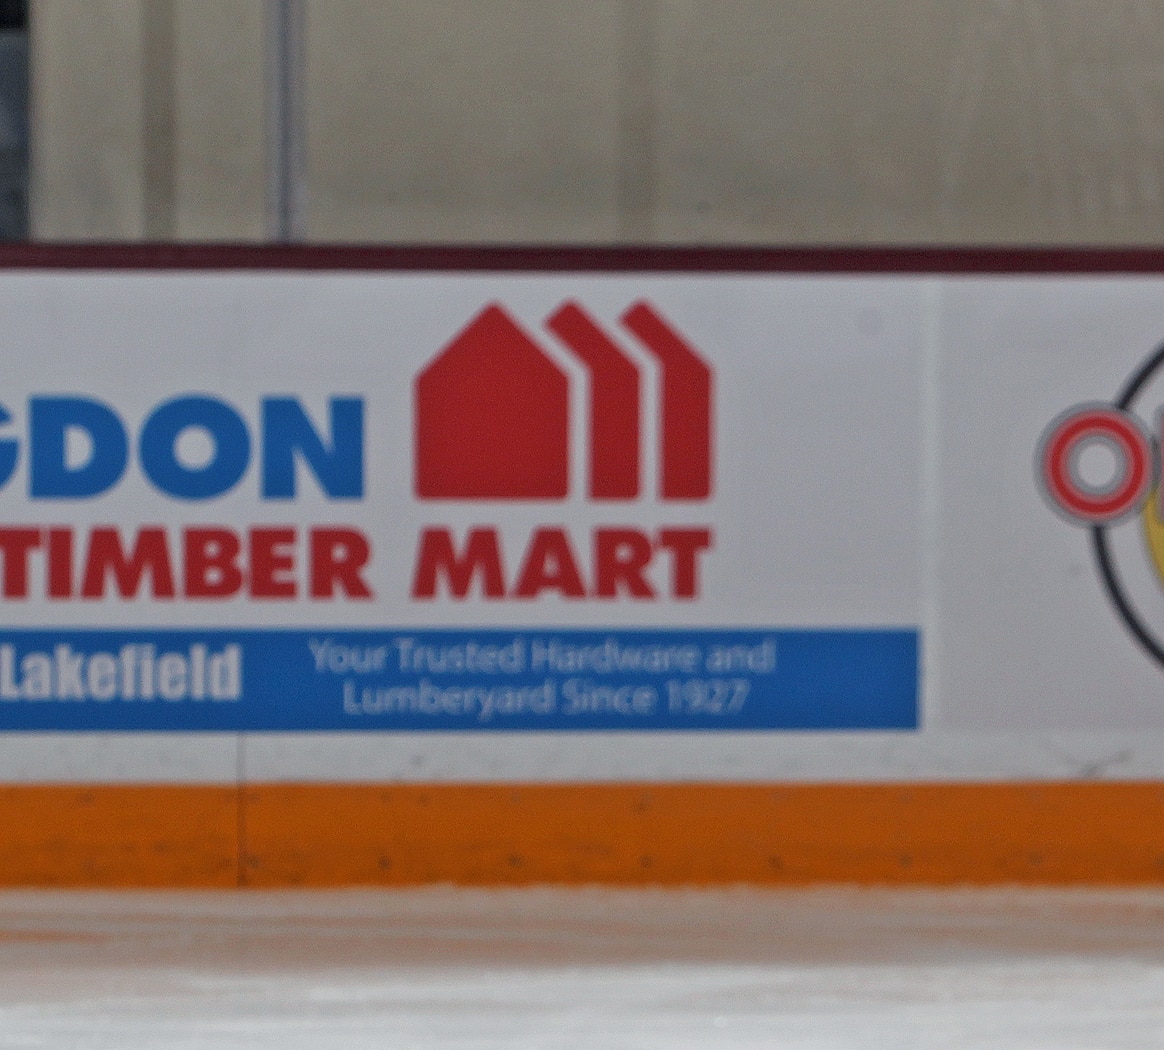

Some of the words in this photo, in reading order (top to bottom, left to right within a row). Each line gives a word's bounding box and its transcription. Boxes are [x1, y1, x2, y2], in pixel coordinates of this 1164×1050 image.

[0, 392, 366, 503] DON
[0, 524, 376, 601] TIMBER
[412, 524, 713, 601] MART
[0, 643, 243, 700] Lakefield
[308, 637, 388, 674] Your
[393, 637, 525, 674] Trusted
[531, 637, 700, 674] Hardware
[706, 637, 777, 674] and
[343, 680, 556, 722] Lumberyard
[562, 680, 660, 715] Since
[667, 680, 754, 715] 1927
